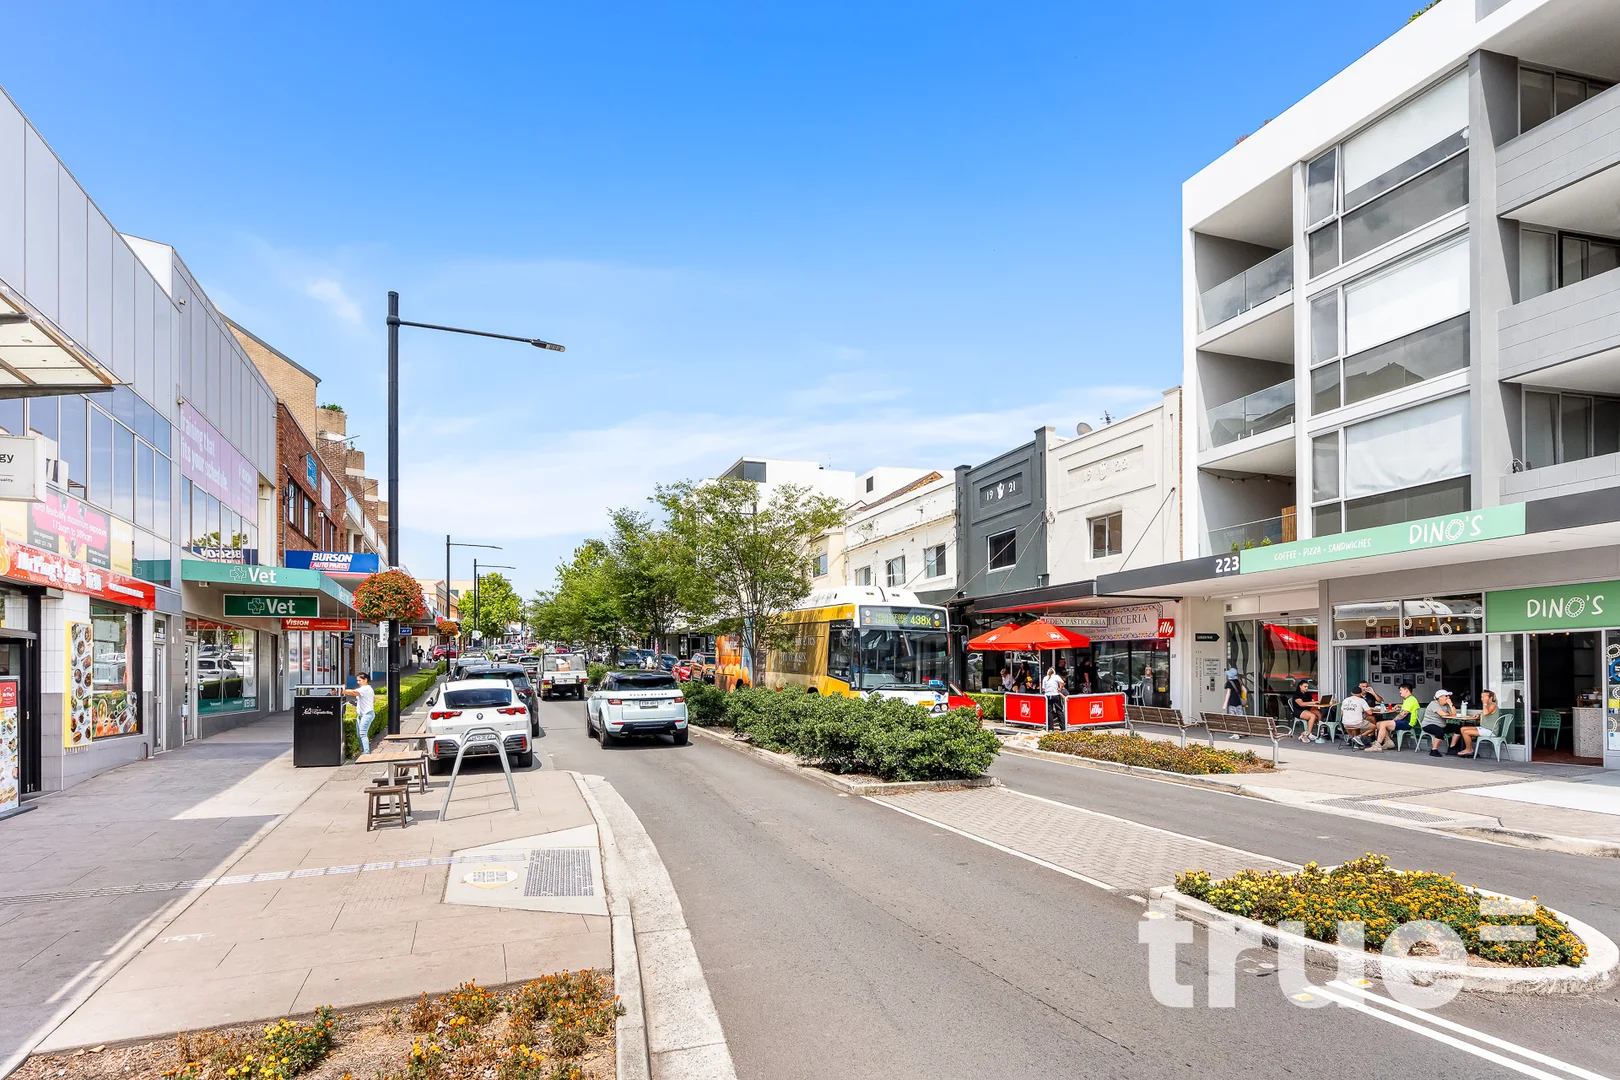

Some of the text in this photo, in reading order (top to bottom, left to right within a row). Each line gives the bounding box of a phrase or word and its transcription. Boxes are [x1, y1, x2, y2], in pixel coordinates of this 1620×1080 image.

[1409, 514, 1483, 545] DINO'S
[1274, 538, 1372, 561] COFFEE PIZZA SANDWICHES
[312, 553, 353, 562] BURSON
[1215, 555, 1239, 573] 223
[248, 568, 276, 584] Vet
[266, 598, 296, 614] Vet
[1527, 595, 1604, 619] DINO'S
[286, 618, 310, 626] VISION
[1066, 618, 1106, 626] PASTICCERIA
[1107, 613, 1148, 625] TICCERIA
[1160, 621, 1173, 636] illy
[1091, 704, 1103, 717] illy
